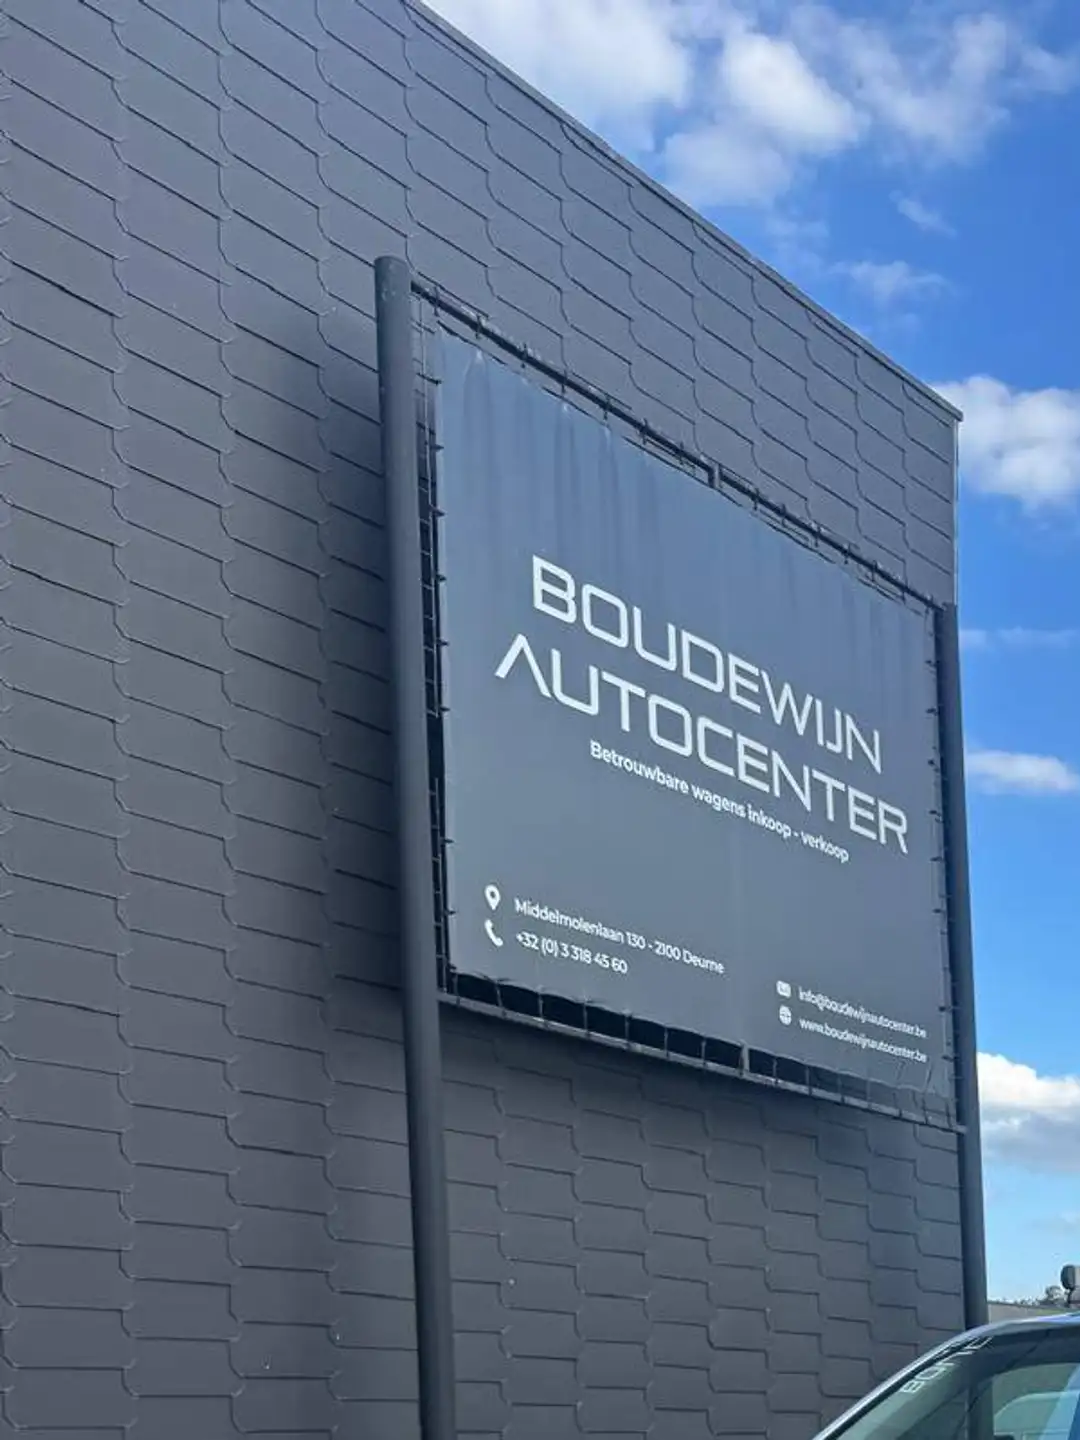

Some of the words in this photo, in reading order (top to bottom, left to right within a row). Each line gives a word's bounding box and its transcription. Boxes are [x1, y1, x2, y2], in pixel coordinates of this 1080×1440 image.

[532, 554, 883, 774] BOUDEWIJN
[495, 633, 908, 854] AUTOCENTER
[590, 739, 689, 793] Betrouwbare
[691, 784, 746, 818] wagens
[747, 803, 791, 839] inkoop
[800, 830, 849, 863] verkoop
[514, 898, 625, 944] Middelmolenlaan
[626, 931, 646, 949] 130
[683, 949, 725, 974] Deurne
[515, 931, 539, 949] +32
[541, 937, 559, 957] (0)
[561, 942, 569, 957] 3
[571, 944, 592, 964] 318
[594, 952, 609, 969] 45
[611, 957, 628, 974] 60
